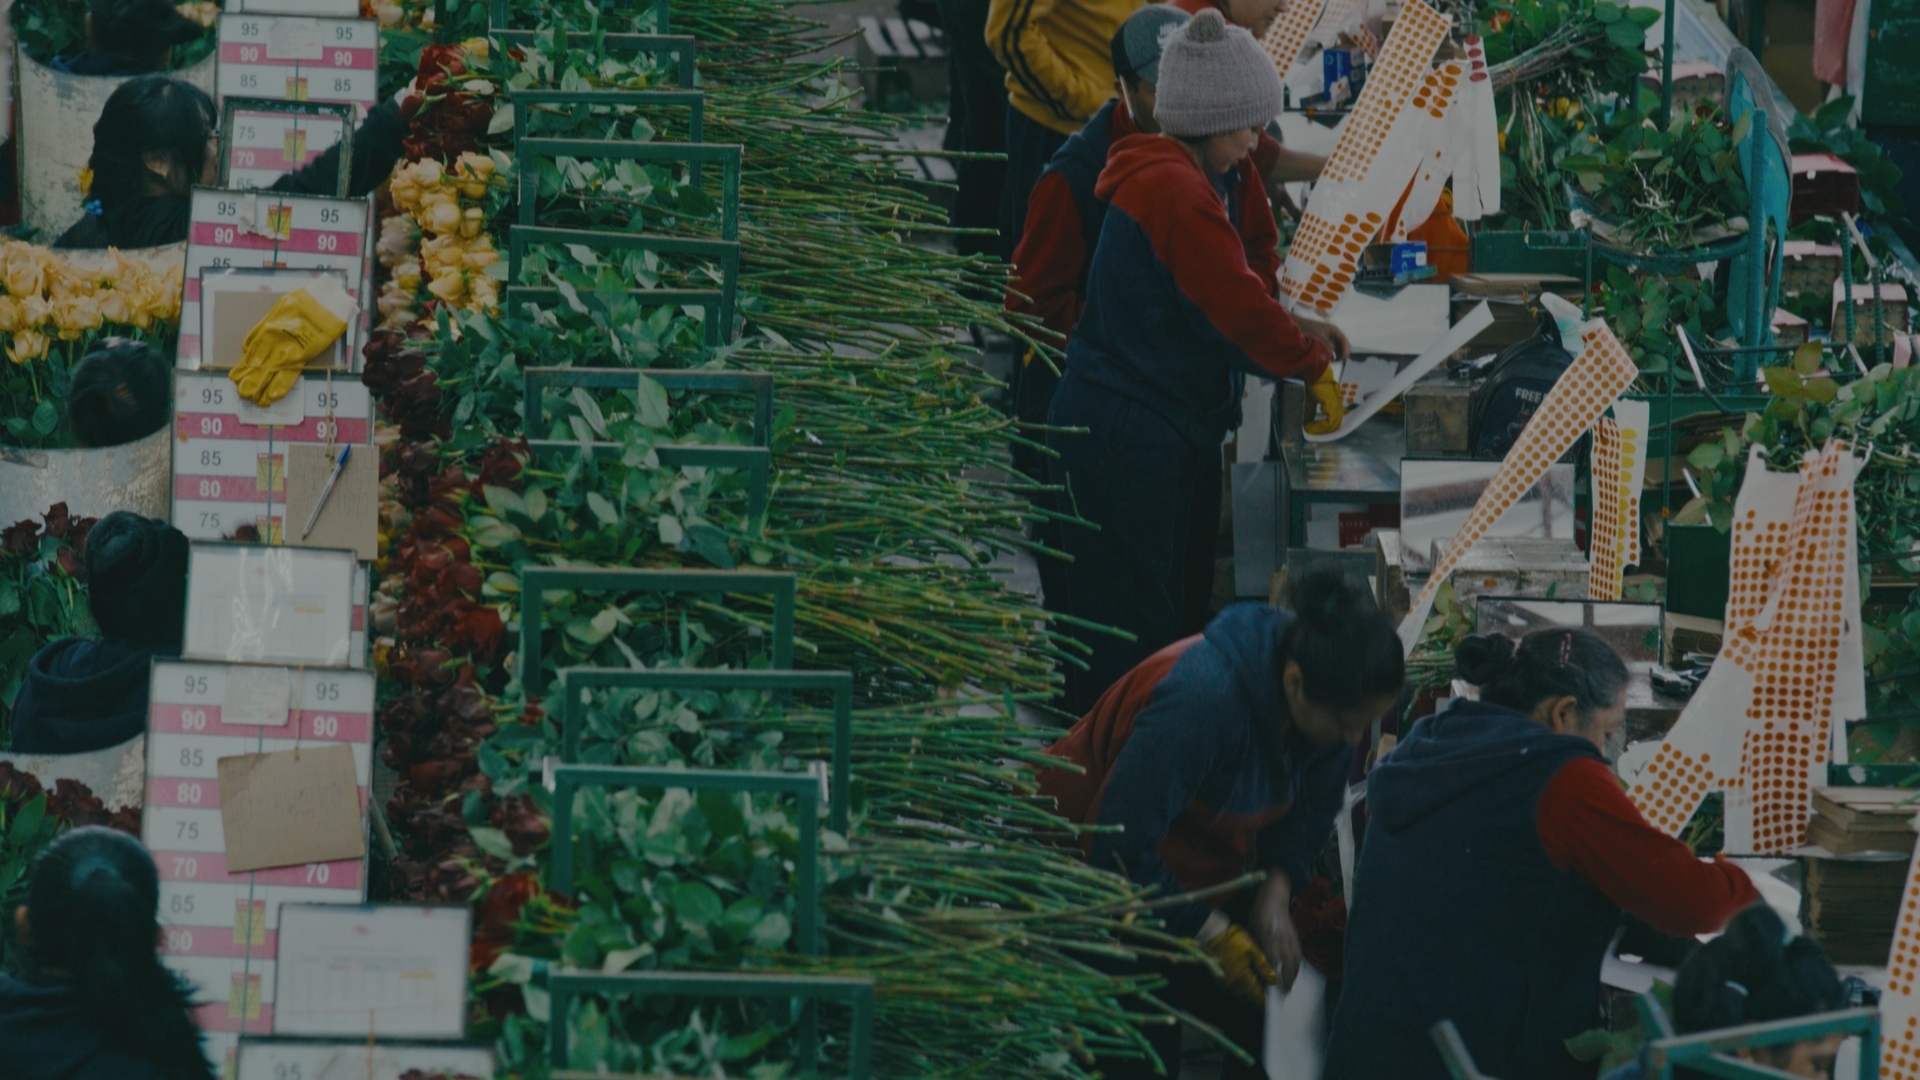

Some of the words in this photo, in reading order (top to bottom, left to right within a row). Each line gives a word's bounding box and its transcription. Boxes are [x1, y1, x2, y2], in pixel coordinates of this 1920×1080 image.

[241, 23, 259, 36] 95
[335, 27, 353, 40] 95
[240, 47, 258, 62] 90
[334, 51, 352, 66] 90
[240, 75, 257, 88] 85
[334, 79, 351, 92] 85
[238, 126, 255, 140] 75
[236, 151, 255, 166] 70
[217, 202, 236, 216] 95
[320, 209, 339, 223] 95
[214, 228, 234, 243] 90
[317, 235, 337, 251] 90
[201, 389, 222, 404] 95
[317, 392, 338, 408] 95
[1515, 387, 1541, 403] FREE
[200, 417, 222, 435] 90
[316, 421, 338, 439] 90
[200, 451, 221, 467] 85
[199, 480, 221, 497] 80
[199, 512, 220, 528] 75
[184, 675, 208, 694] 95
[316, 682, 339, 701] 95
[181, 710, 206, 731] 90
[313, 717, 338, 738] 90
[179, 748, 204, 767] 85
[177, 783, 202, 804] 80
[175, 821, 199, 840] 75
[173, 857, 197, 877] 70
[305, 863, 329, 883] 70
[171, 894, 195, 913] 65
[168, 931, 193, 951] 60
[275, 1062, 300, 1080] 95
